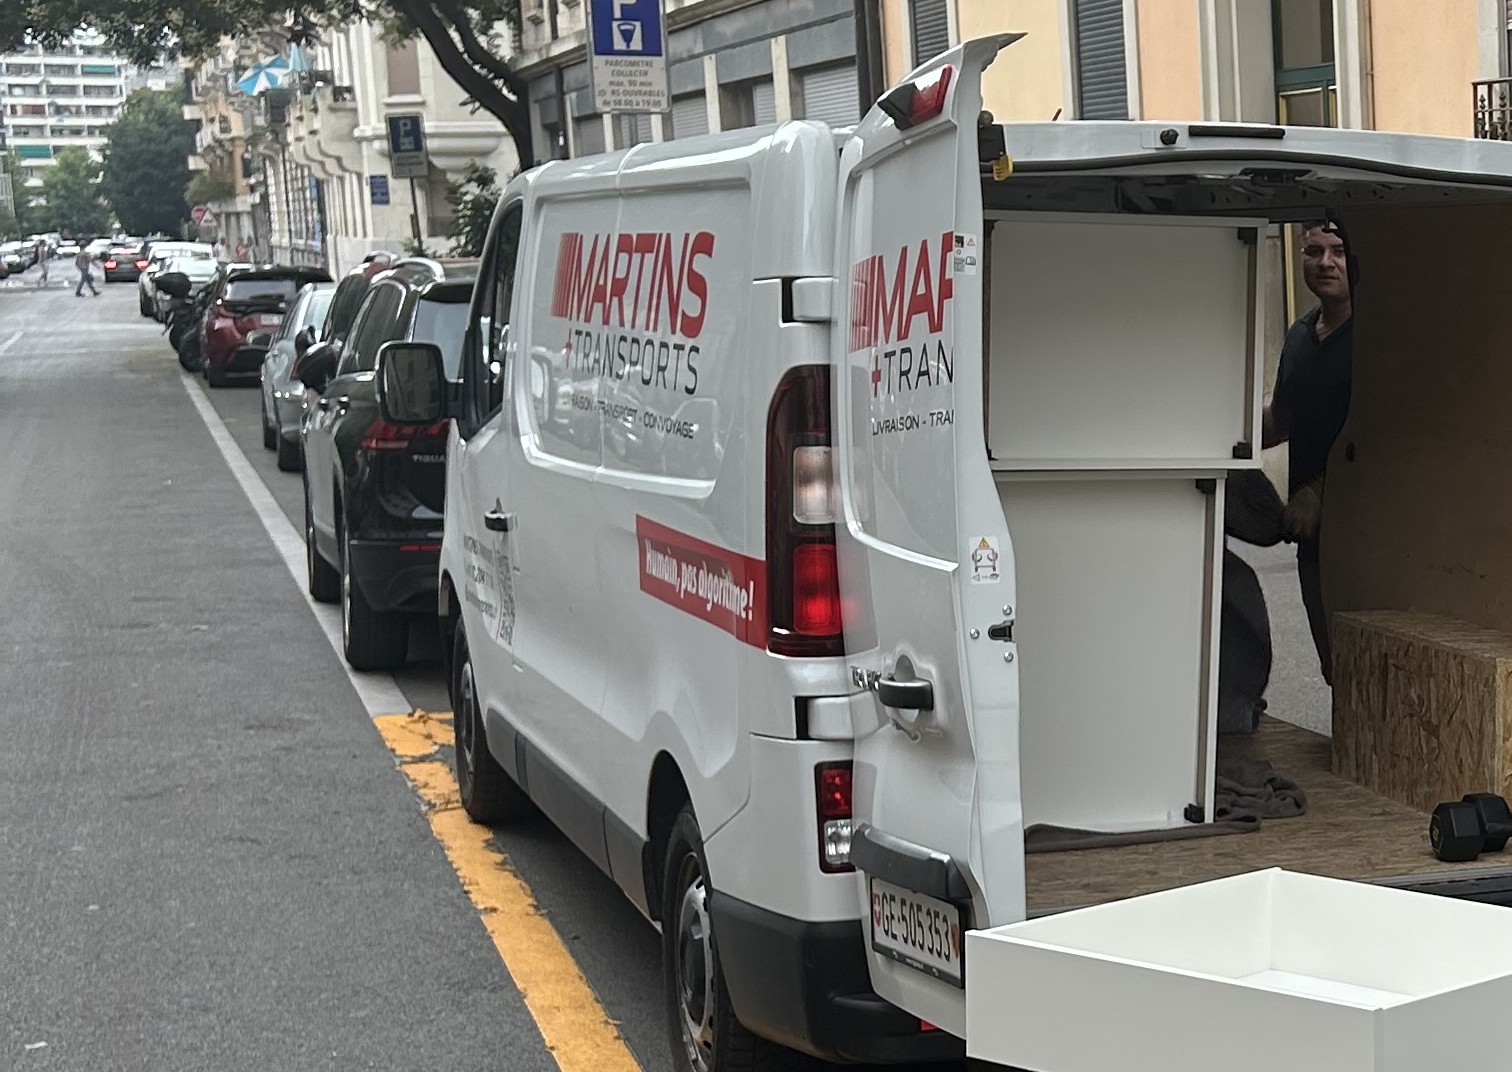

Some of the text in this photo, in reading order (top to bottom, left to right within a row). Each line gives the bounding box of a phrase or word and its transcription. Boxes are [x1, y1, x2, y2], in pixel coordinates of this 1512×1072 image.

[400, 119, 412, 138] P
[569, 231, 715, 339] MARTINS
[643, 411, 694, 439] CONVOYAGE
[872, 414, 920, 436] LIVRAISON
[681, 561, 697, 599] pas
